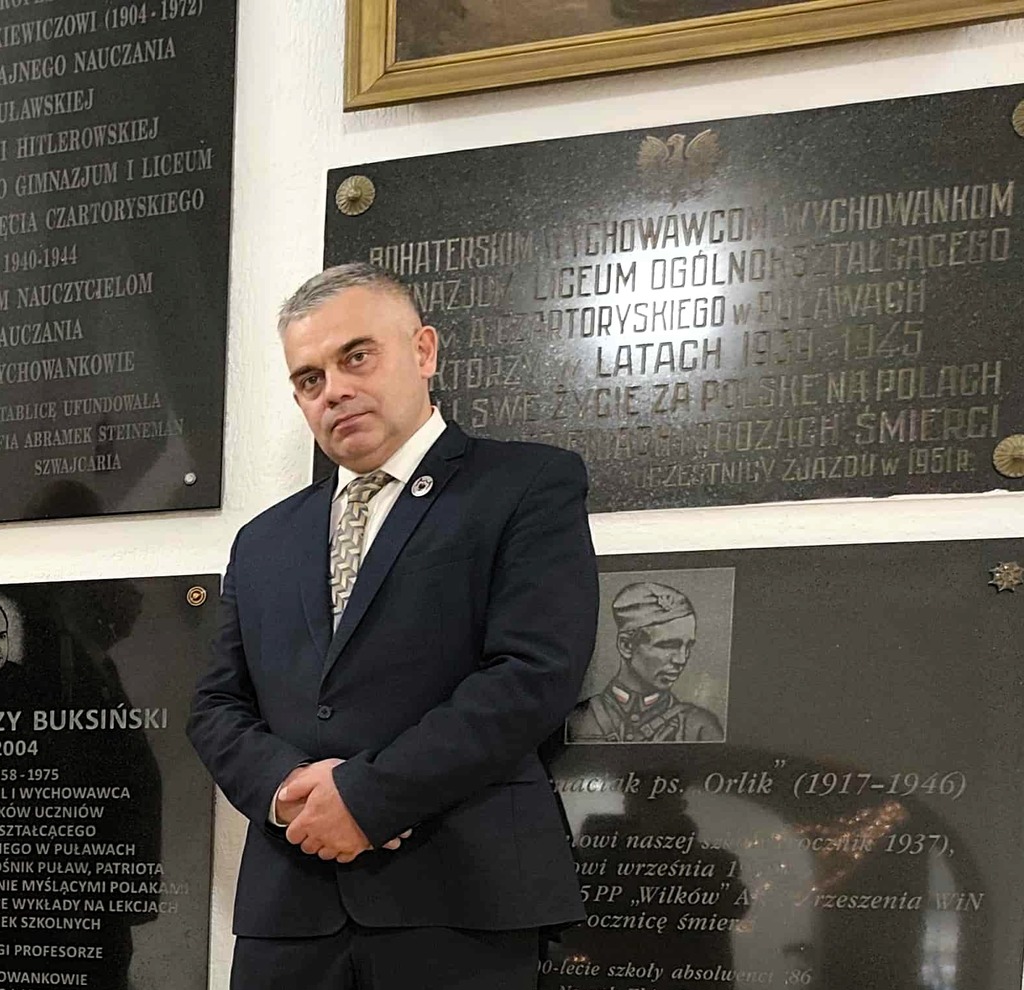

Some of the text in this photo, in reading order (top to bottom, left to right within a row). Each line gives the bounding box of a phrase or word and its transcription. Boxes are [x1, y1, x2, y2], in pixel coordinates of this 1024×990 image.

[73, 36, 177, 74] NAUCZANIA
[16, 116, 160, 160] HITLEROWSKIEJ
[15, 162, 118, 199] GIMNAZJUM
[127, 158, 134, 182] I
[141, 148, 214, 179] LICEUM
[45, 188, 205, 231] CZARTORYSKIEGO
[17, 272, 154, 310] NAUCZYCIELOM
[534, 260, 637, 301] LICEUM
[595, 335, 722, 379] LATACH
[24, 426, 93, 449] ABRAMEK
[34, 453, 123, 476] SZWAJCARIA
[33, 702, 168, 731] BUKSIŃSKI
[19, 787, 131, 800] WYCHOWAWCA
[647, 775, 684, 799] ps.
[34, 803, 105, 818] UCZNIÓW
[35, 843, 50, 855] W
[54, 843, 136, 856] PUŁAWACH
[626, 831, 696, 854] naszej
[38, 862, 92, 876] PUŁAW,
[95, 863, 165, 875] PATRIOTA
[617, 859, 715, 877] września
[22, 877, 106, 895] MYŚLĄCYMI
[12, 898, 82, 911] WYKŁADY
[84, 899, 105, 912] NA
[20, 917, 101, 930] SZKOLNYCH
[14, 945, 103, 959] PROFESORZE
[607, 963, 664, 983] szkoły
